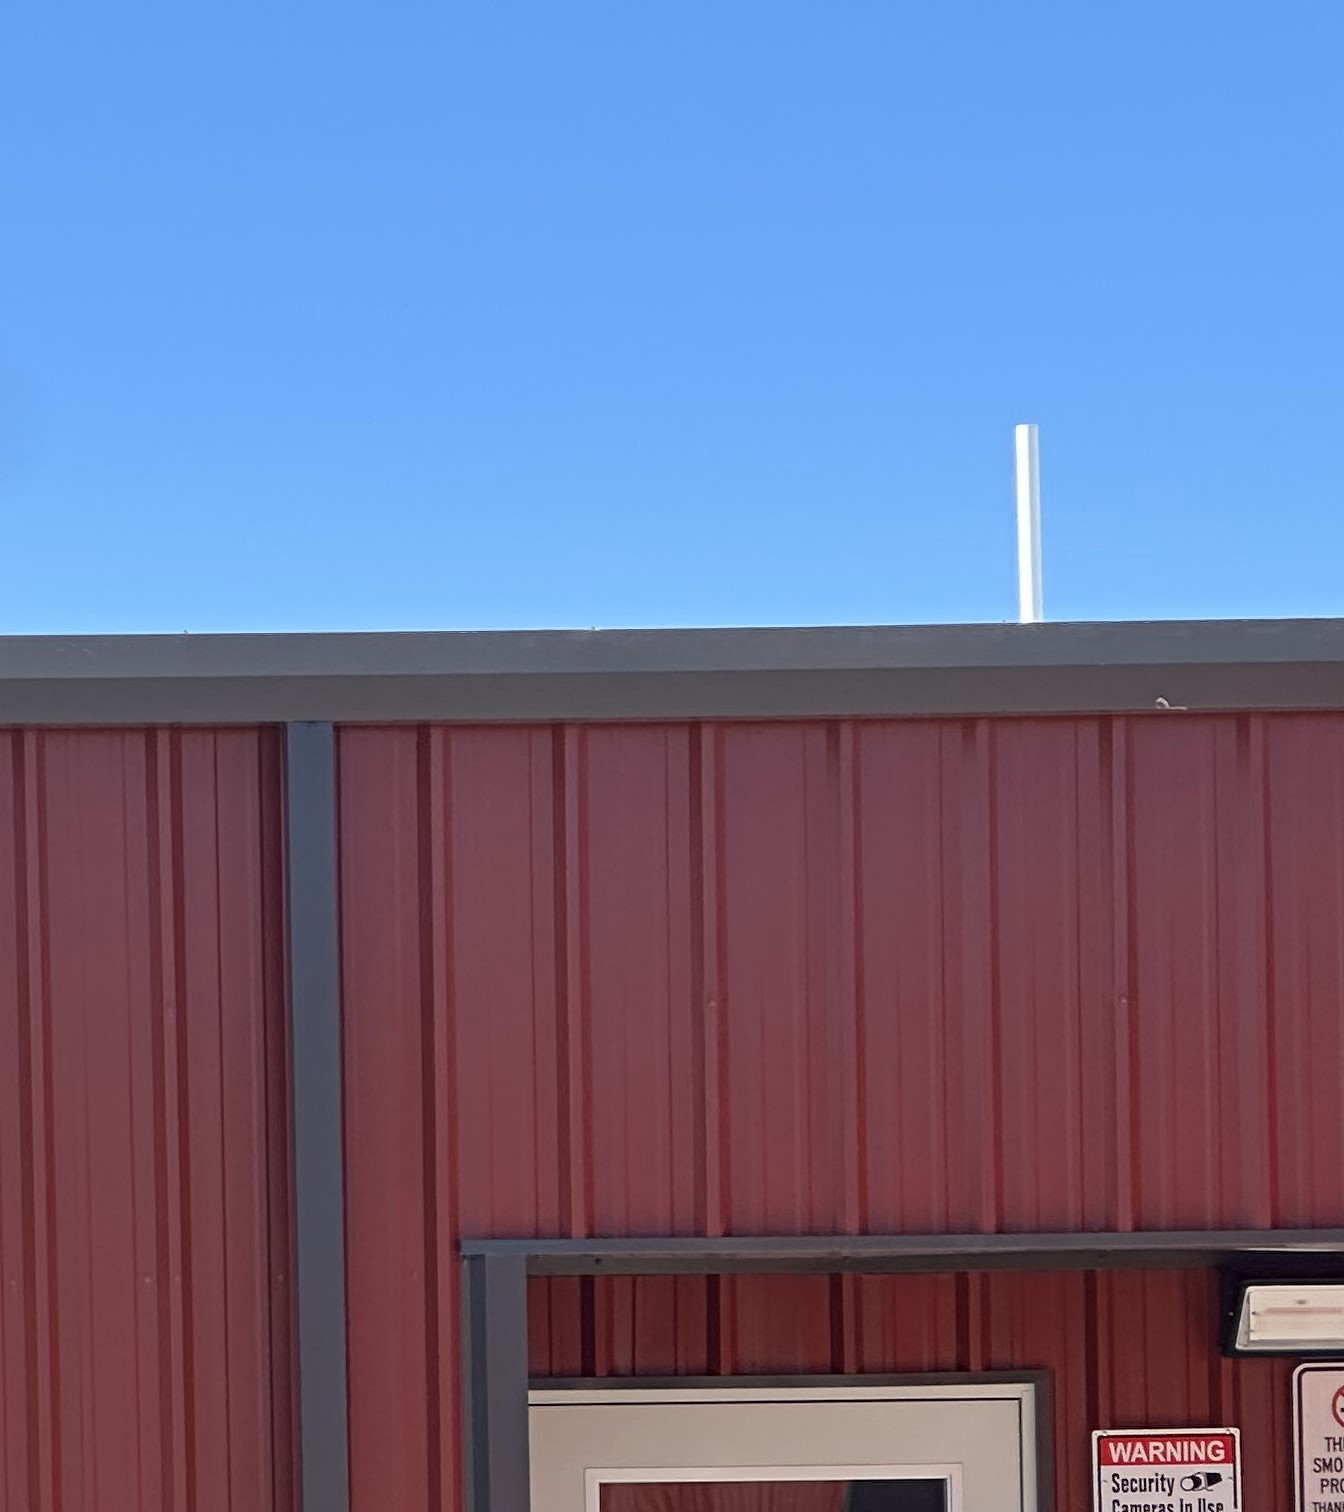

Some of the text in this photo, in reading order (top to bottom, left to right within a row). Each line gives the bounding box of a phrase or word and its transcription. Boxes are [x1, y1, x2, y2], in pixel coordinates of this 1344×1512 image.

[1108, 1440, 1225, 1463] WARNING
[1313, 1457, 1344, 1474] SMO
[1111, 1472, 1175, 1497] Security
